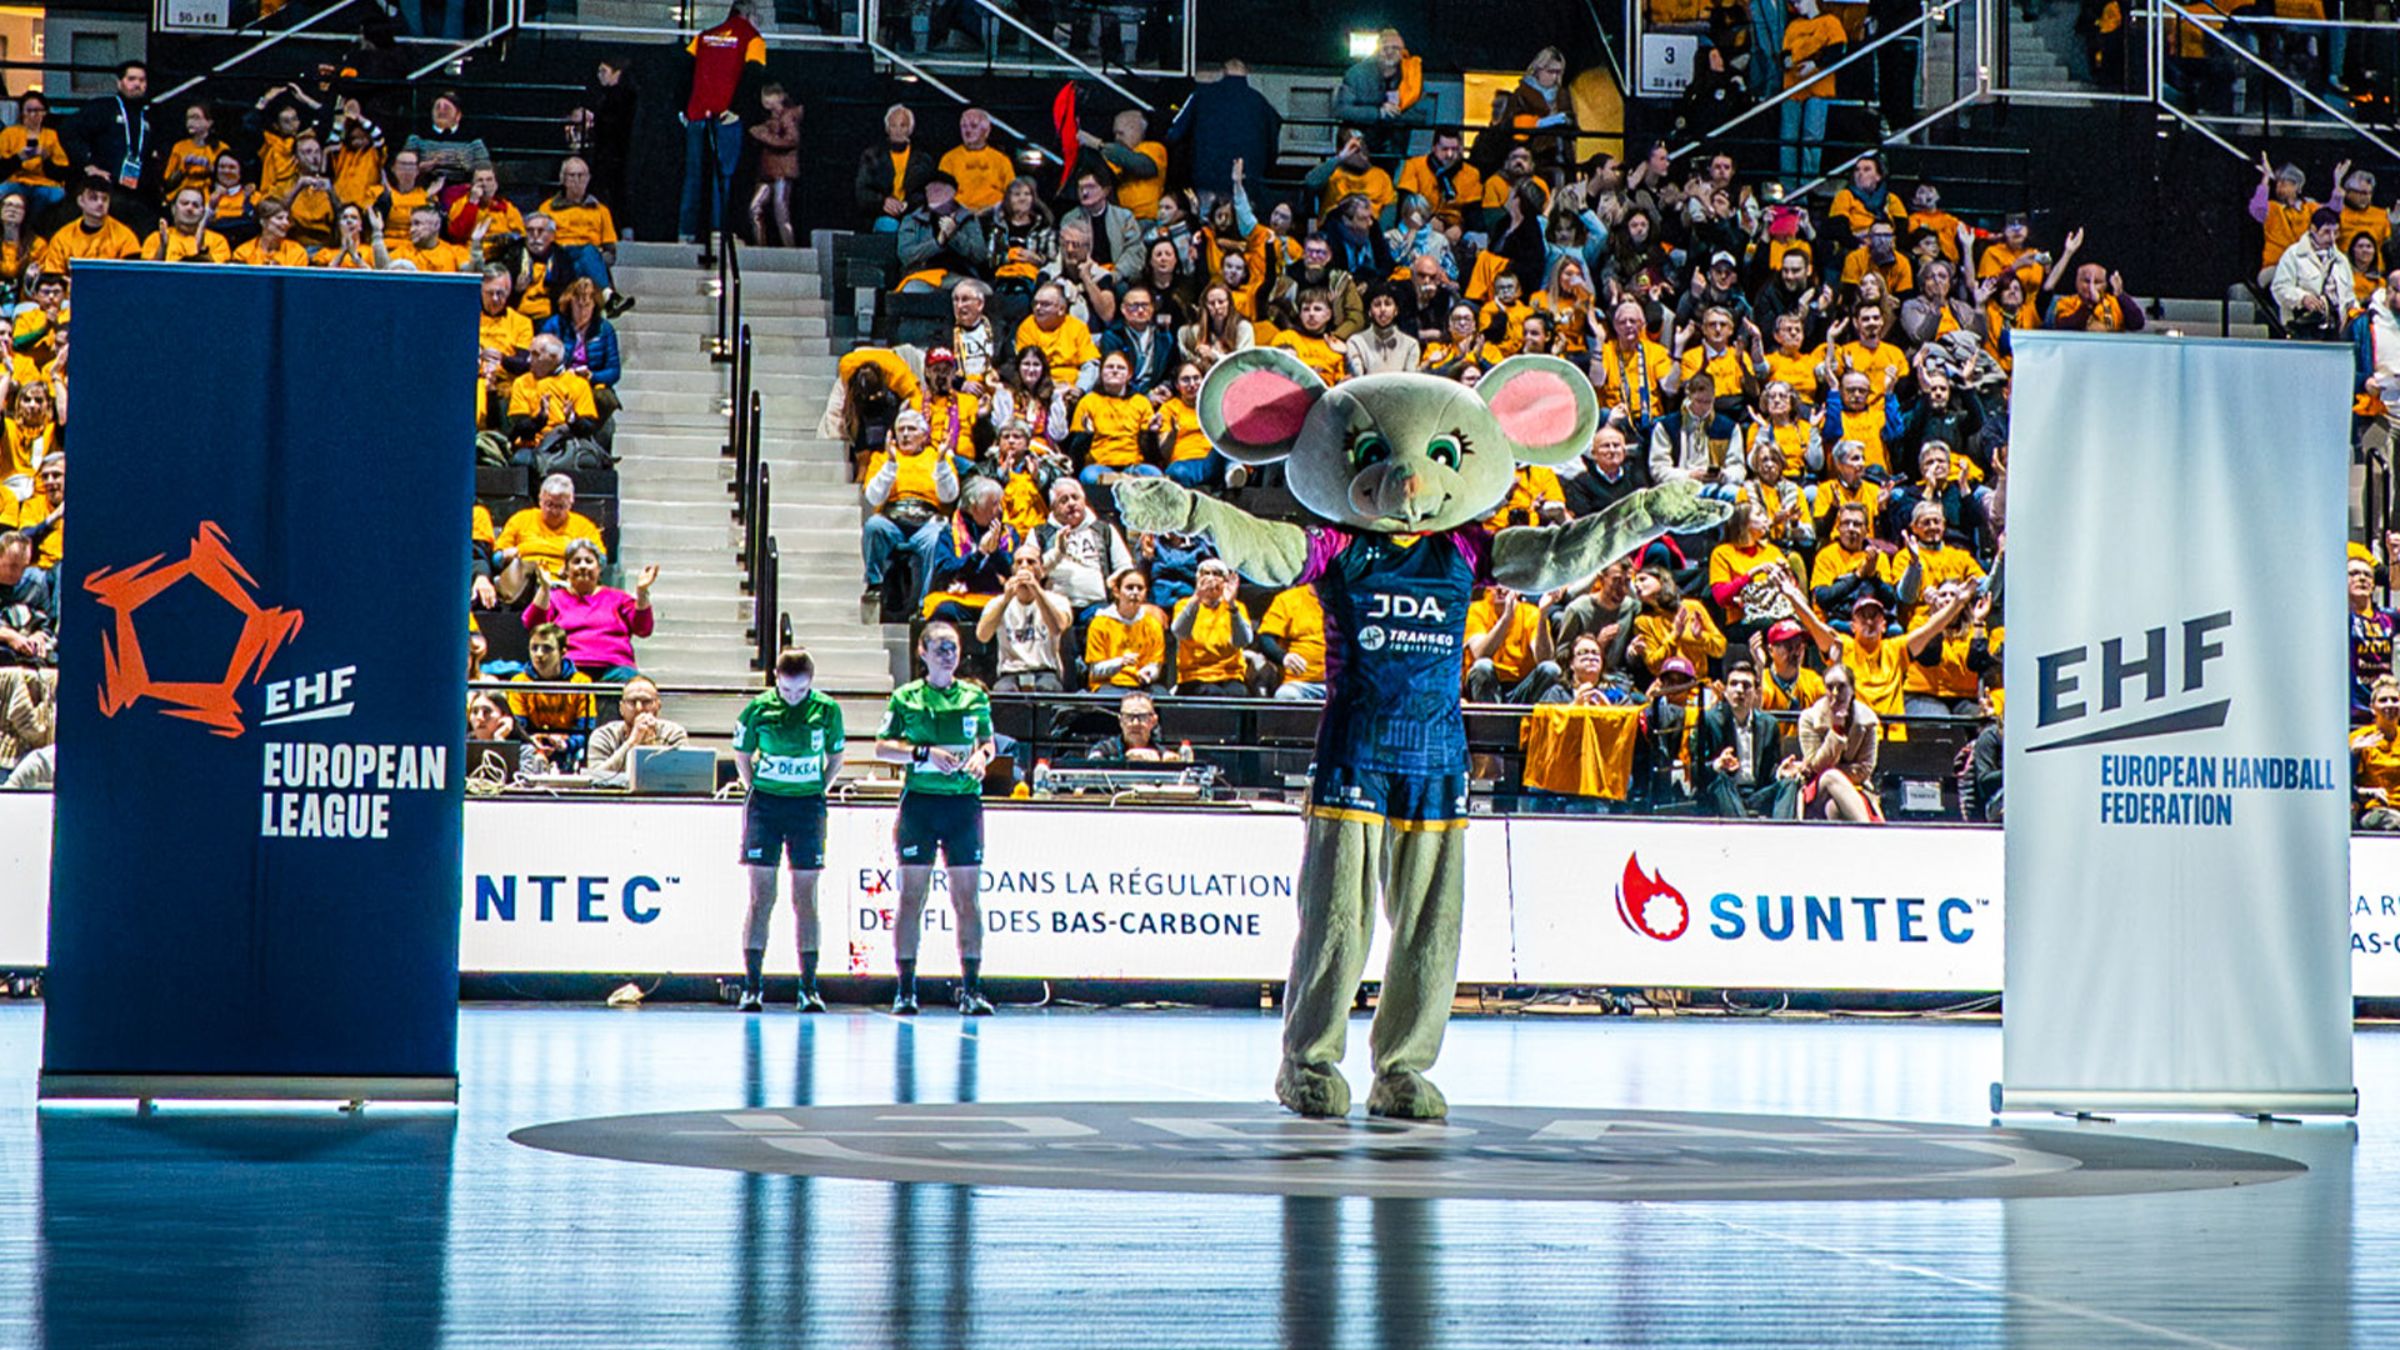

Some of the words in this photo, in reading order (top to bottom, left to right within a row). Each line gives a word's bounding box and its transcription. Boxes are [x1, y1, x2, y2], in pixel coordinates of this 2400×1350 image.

[1664, 46, 1676, 65] 3
[1367, 594, 1446, 622] JDA
[2036, 610, 2232, 728] EHF
[265, 665, 357, 716] EHF
[264, 742, 446, 789] EUROPEAN
[2101, 755, 2216, 788] EUROPEAN
[2223, 757, 2335, 790] HANDBALL
[262, 792, 389, 838] LEAGUE
[2101, 792, 2232, 826] FEDERATION
[1066, 872, 1099, 894] LA
[1109, 867, 1291, 897] RÉGULATION
[475, 874, 680, 925] NTEC™
[2349, 895, 2372, 916] A
[2381, 895, 2400, 916] R
[860, 908, 894, 931] DE
[1052, 911, 1260, 935] BAS-CARBONE
[2350, 932, 2400, 954] AS-
